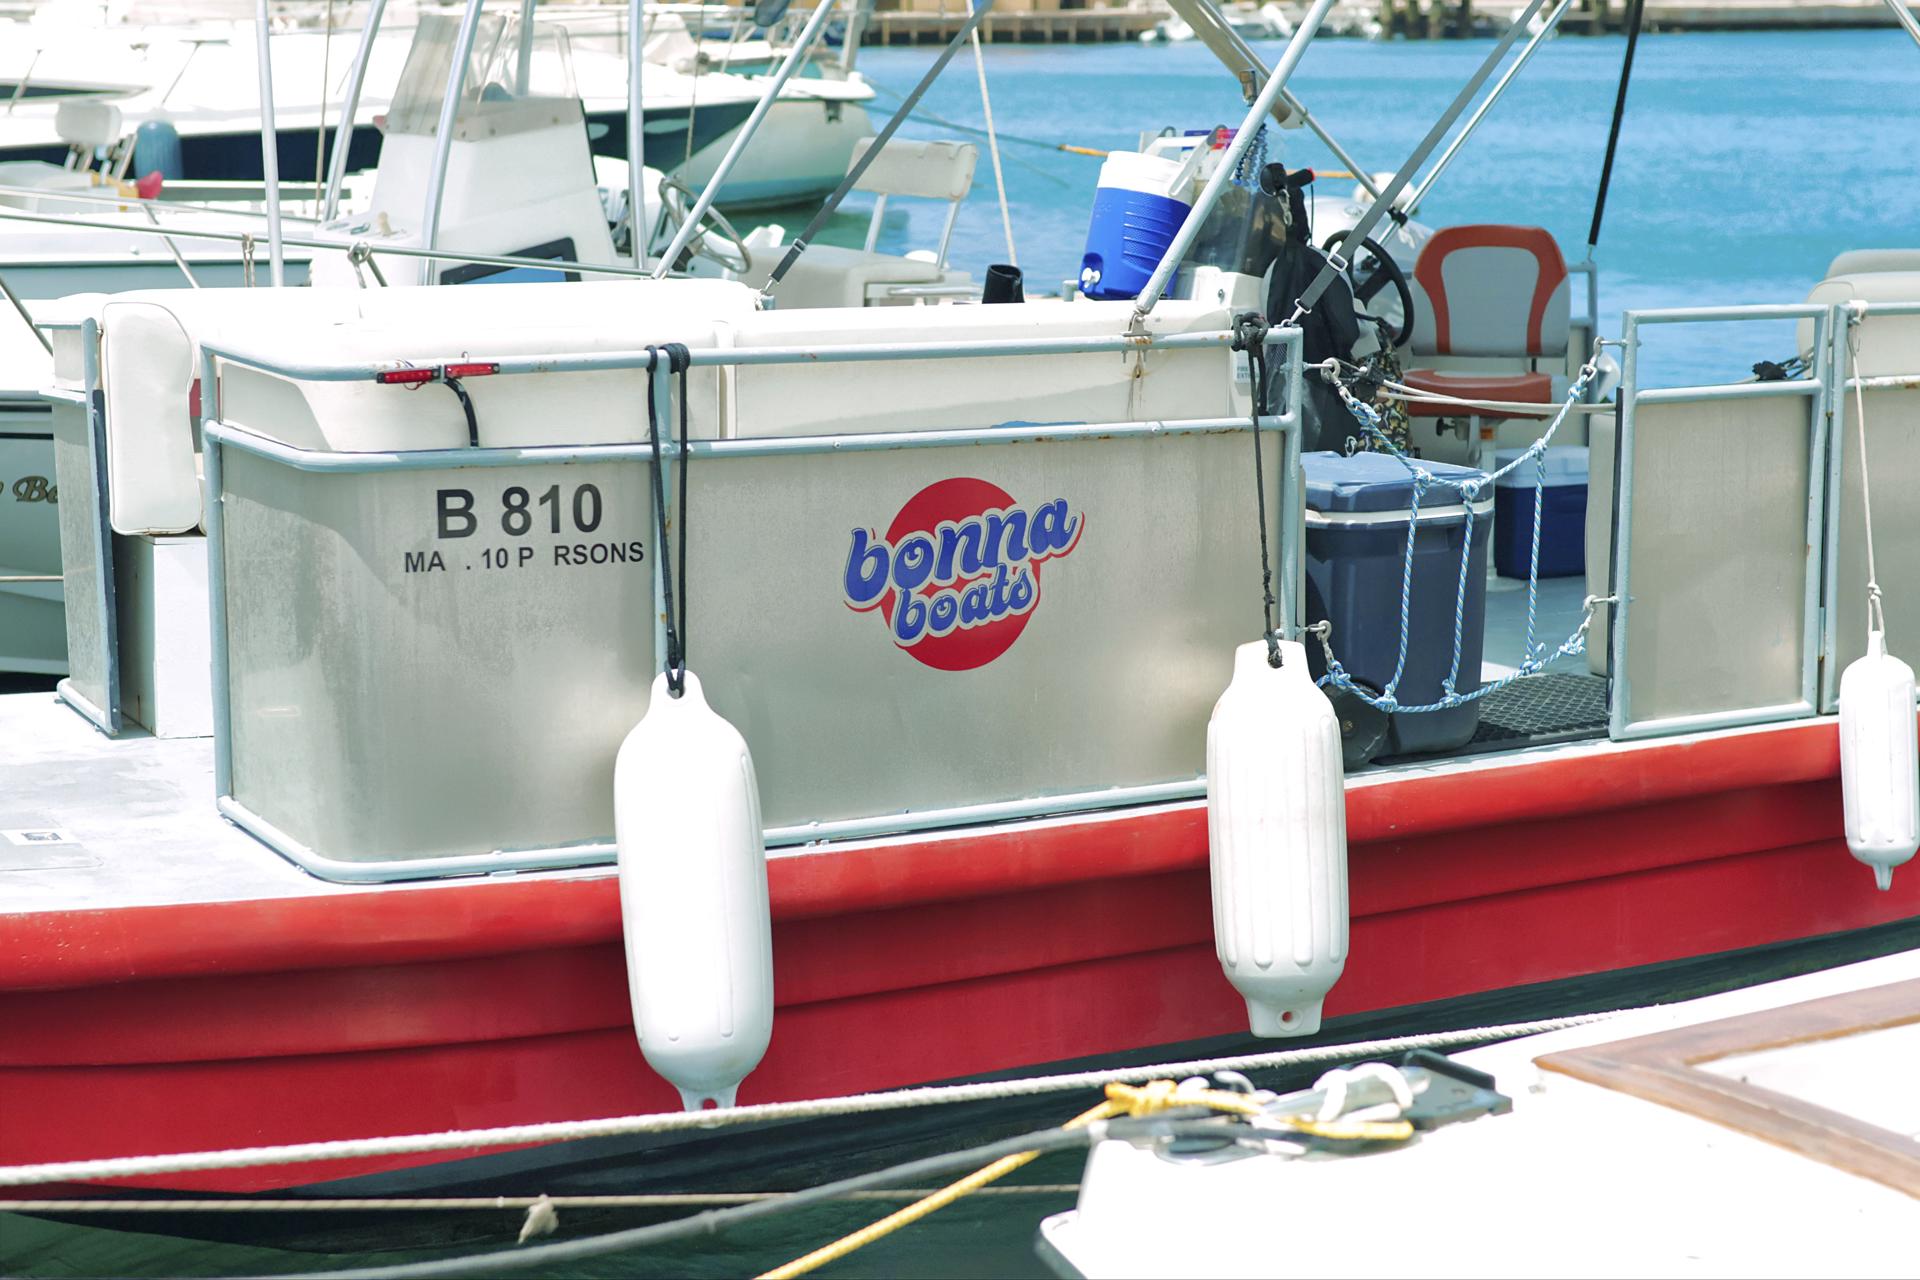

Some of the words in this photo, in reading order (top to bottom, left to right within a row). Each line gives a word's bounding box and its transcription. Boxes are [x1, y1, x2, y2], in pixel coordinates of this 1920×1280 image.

[436, 488, 478, 540] B
[501, 483, 603, 537] 810
[843, 498, 1078, 602] bonna
[894, 563, 1034, 641] boats
